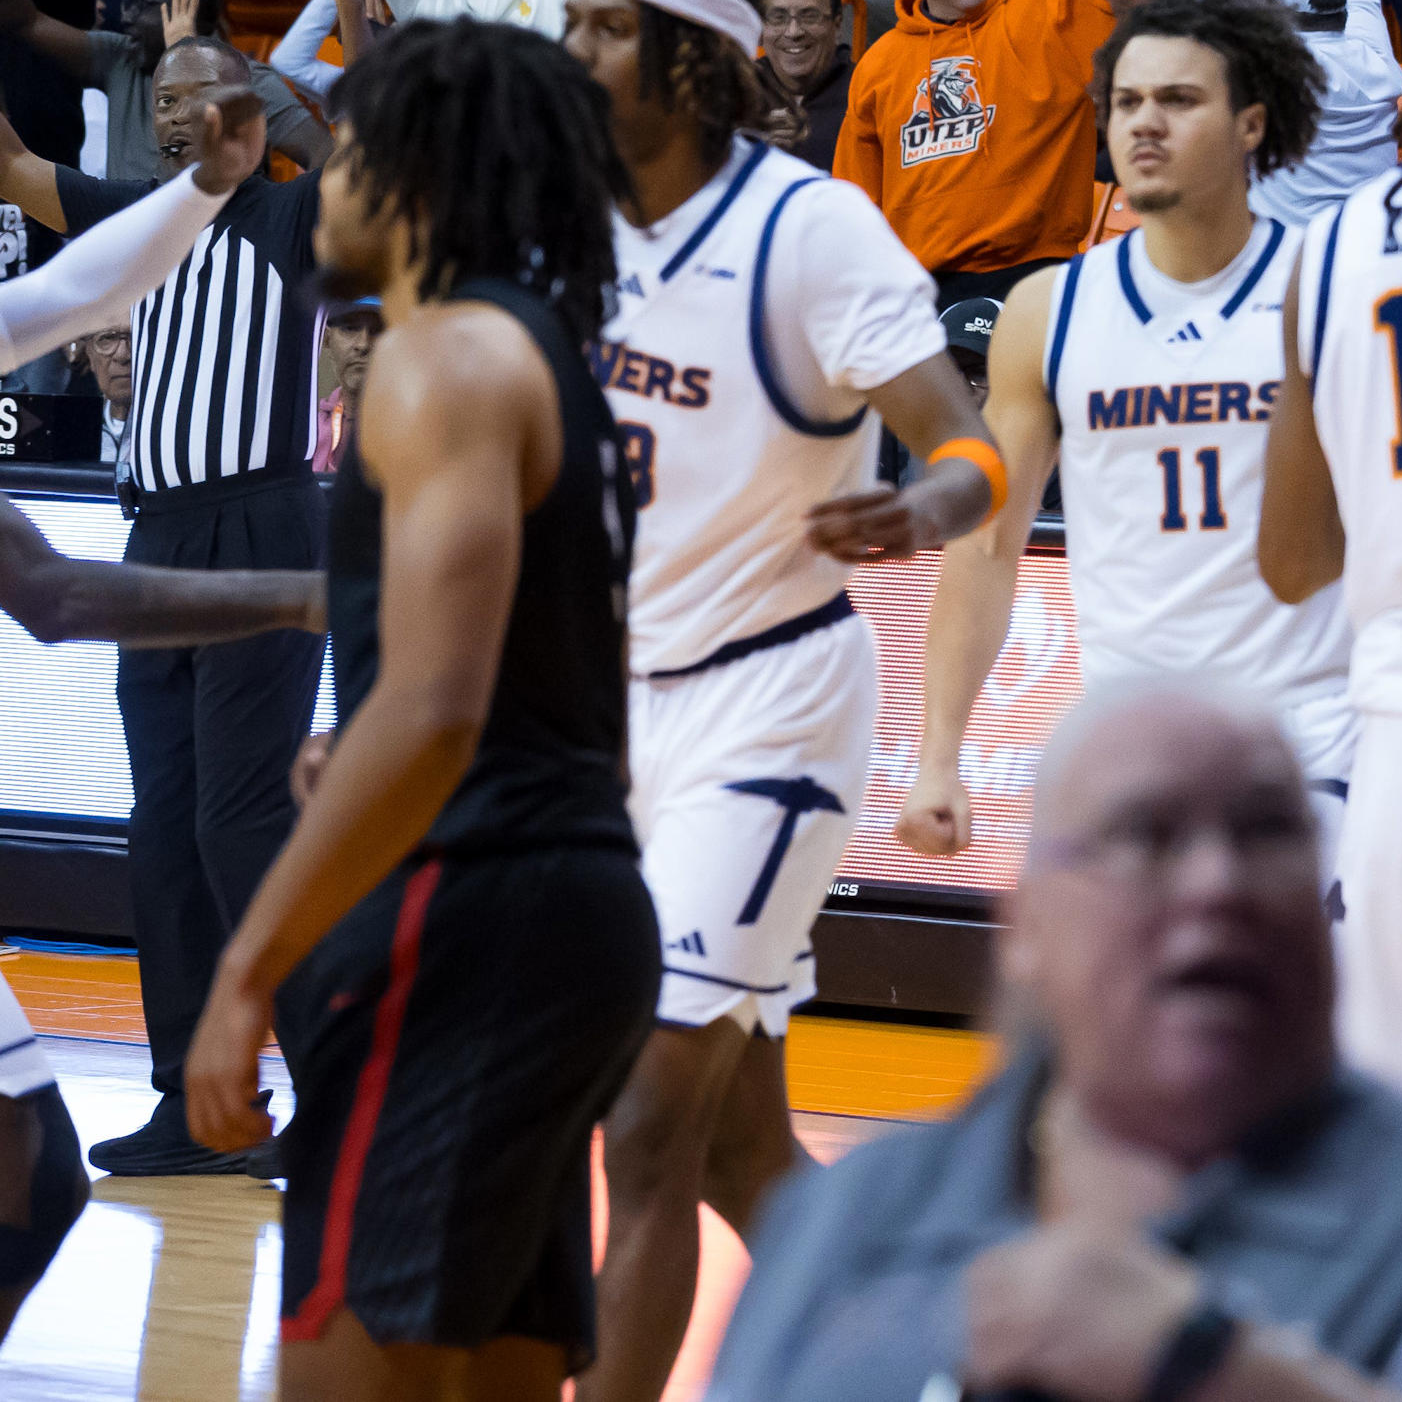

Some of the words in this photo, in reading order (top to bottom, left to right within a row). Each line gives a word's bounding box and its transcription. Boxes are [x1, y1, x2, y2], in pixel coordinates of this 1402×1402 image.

[907, 118, 985, 148] UTEP
[907, 138, 972, 160] MINERS
[974, 317, 992, 328] DV
[1157, 446, 1229, 533] 11
